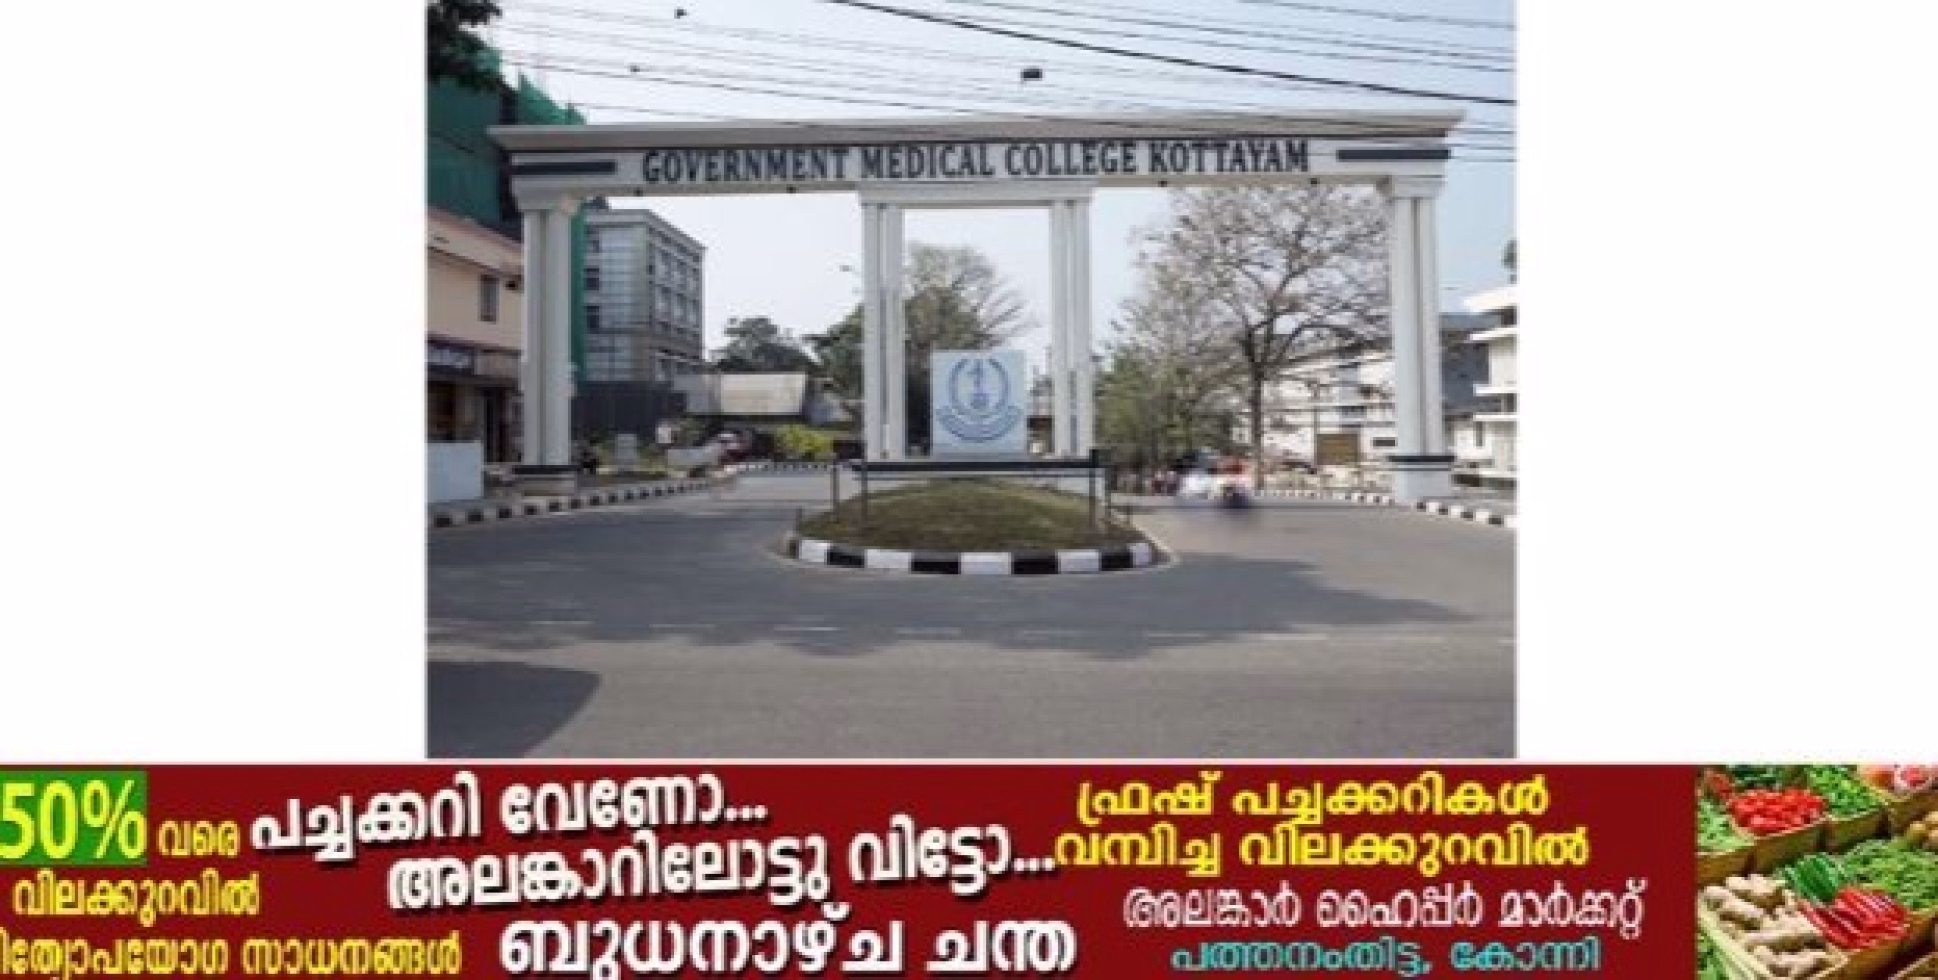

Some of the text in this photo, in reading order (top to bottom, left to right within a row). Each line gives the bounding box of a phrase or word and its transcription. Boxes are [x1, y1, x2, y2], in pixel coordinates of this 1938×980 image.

[642, 138, 1310, 183] GOVERNMENT MEDICAL COLLEGE KOTTAYAM
